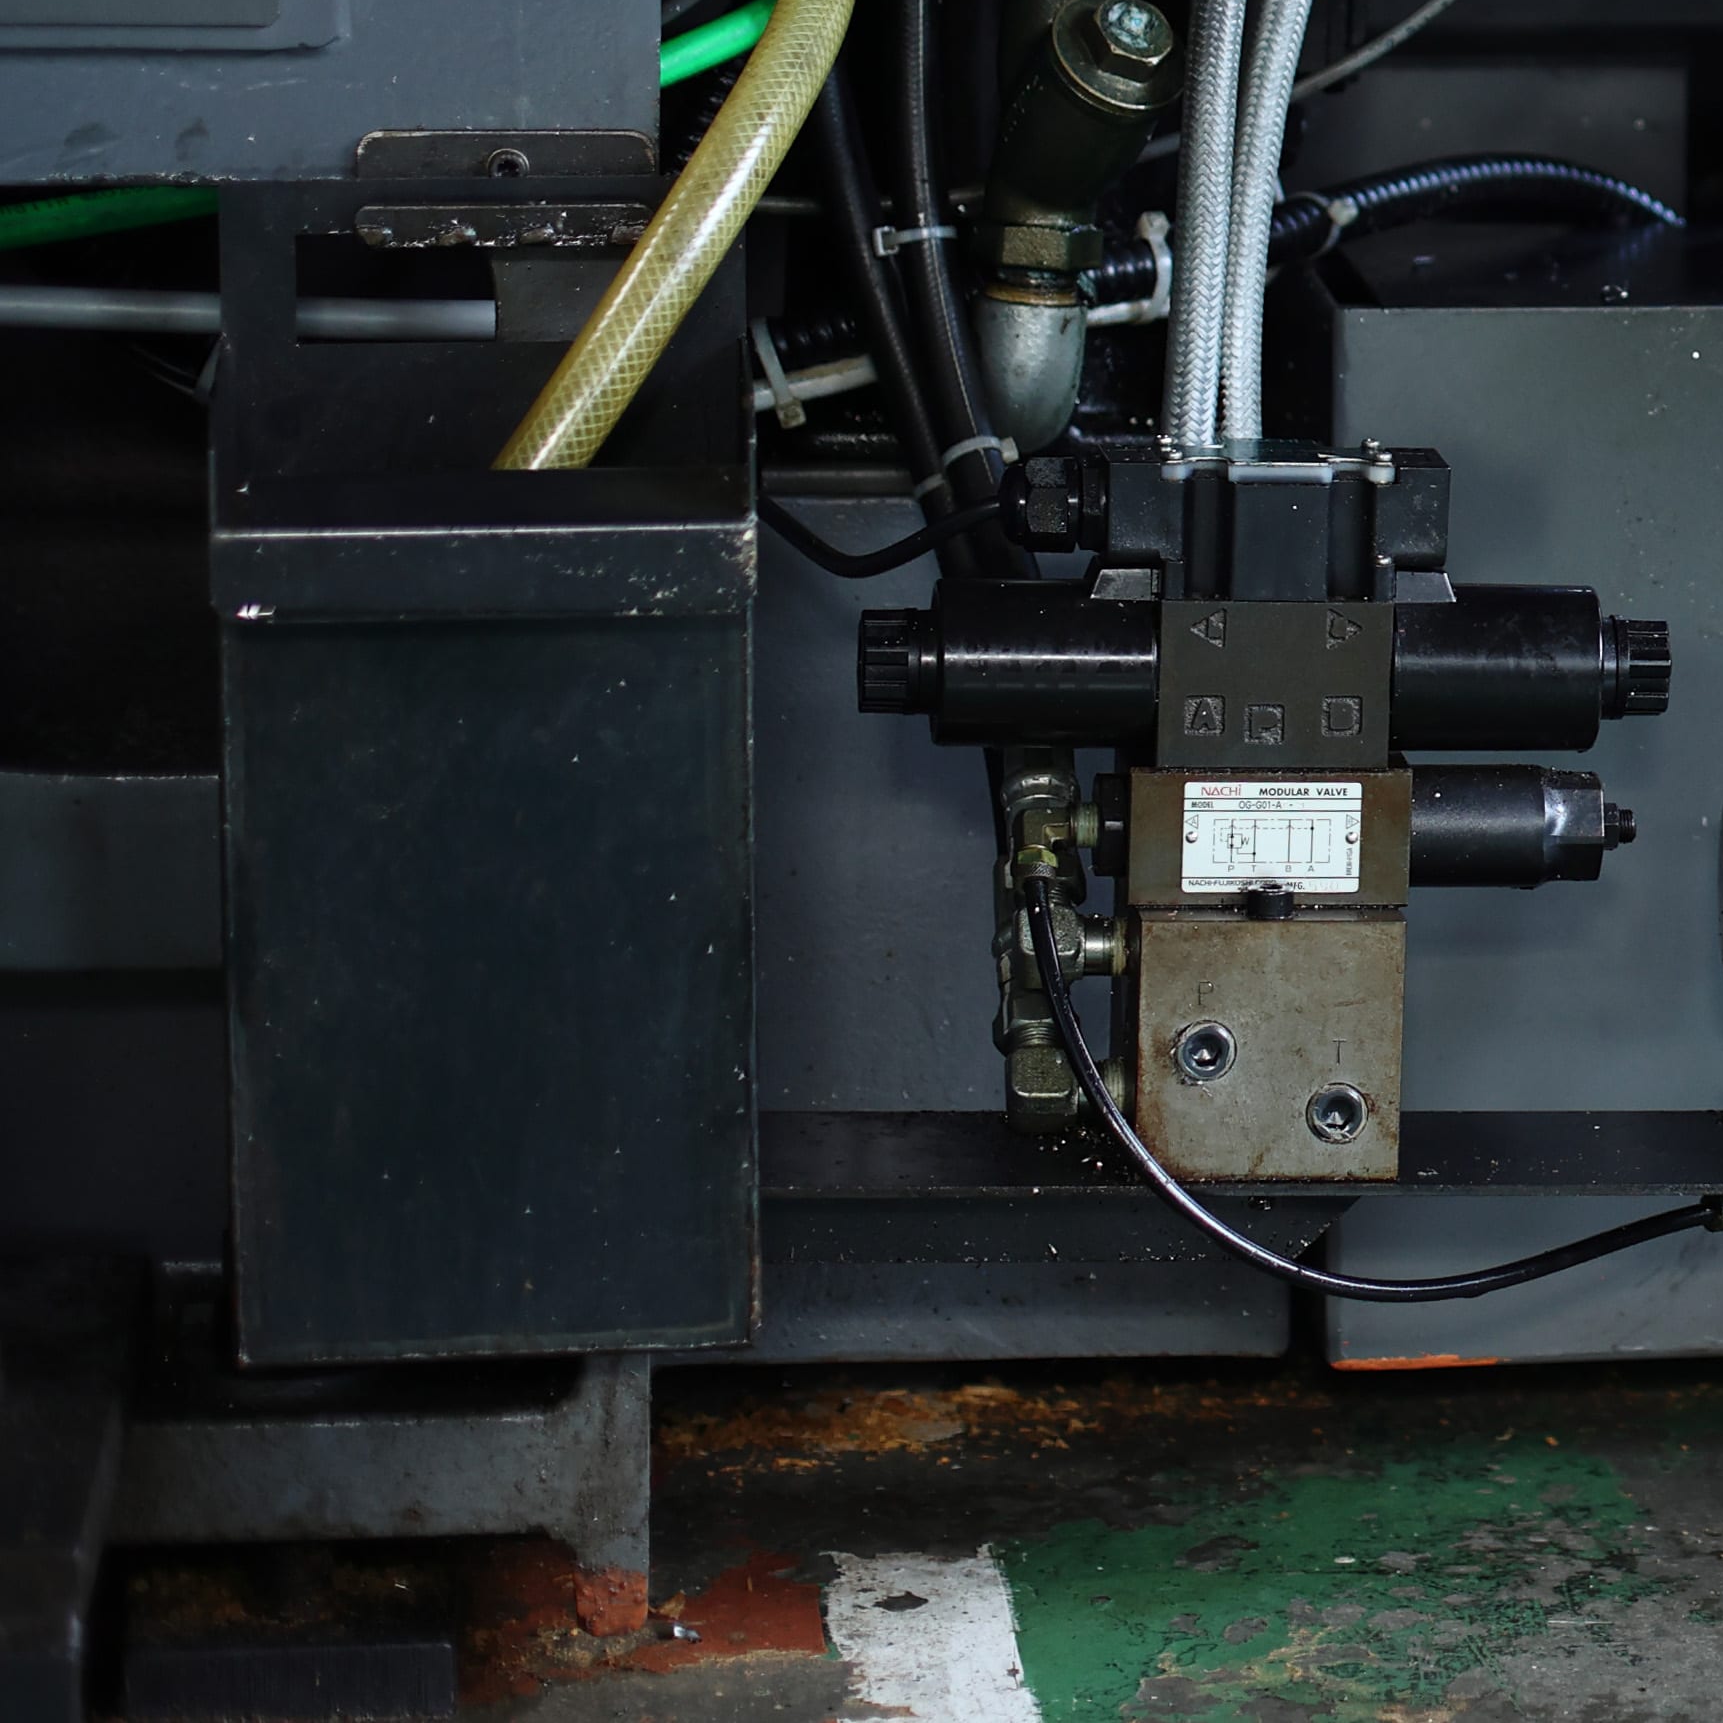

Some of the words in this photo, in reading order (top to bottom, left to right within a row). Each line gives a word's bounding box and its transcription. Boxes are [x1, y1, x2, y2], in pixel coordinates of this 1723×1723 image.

[1259, 787, 1310, 797] MODULAR
[1316, 787, 1348, 797] VALVE
[1191, 801, 1214, 809] MODEL
[1197, 980, 1215, 1006] P
[1332, 1040, 1348, 1065] T
